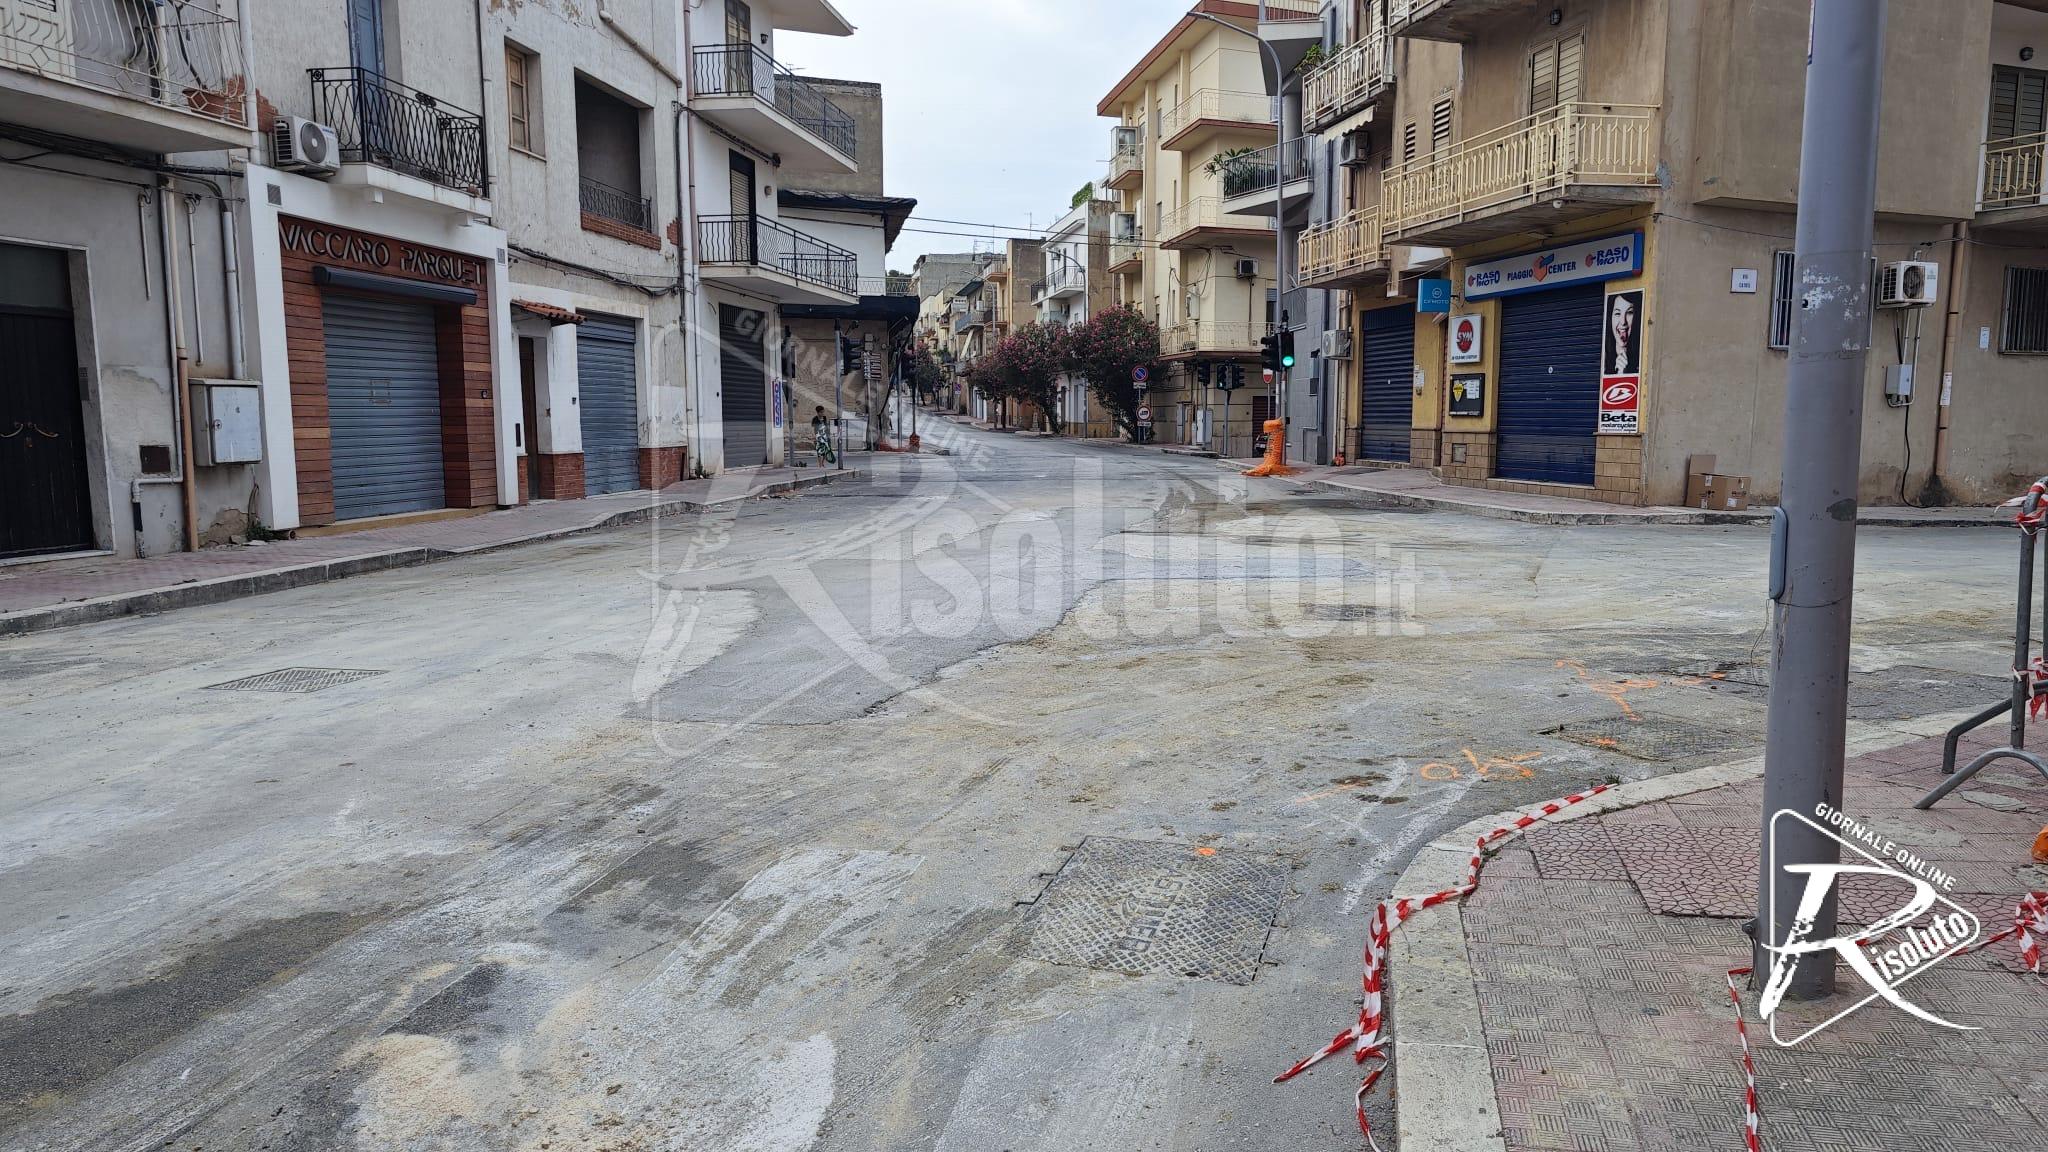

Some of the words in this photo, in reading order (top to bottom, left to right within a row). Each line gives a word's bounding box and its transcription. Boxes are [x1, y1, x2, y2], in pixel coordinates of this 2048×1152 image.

[279, 220, 390, 267] VACCARO
[400, 246, 481, 285] PARQUET
[1507, 268, 1534, 281] PIAGGIO
[1548, 261, 1577, 274] CENTER
[1456, 330, 1474, 343] SYM
[1600, 412, 1637, 423] Beta
